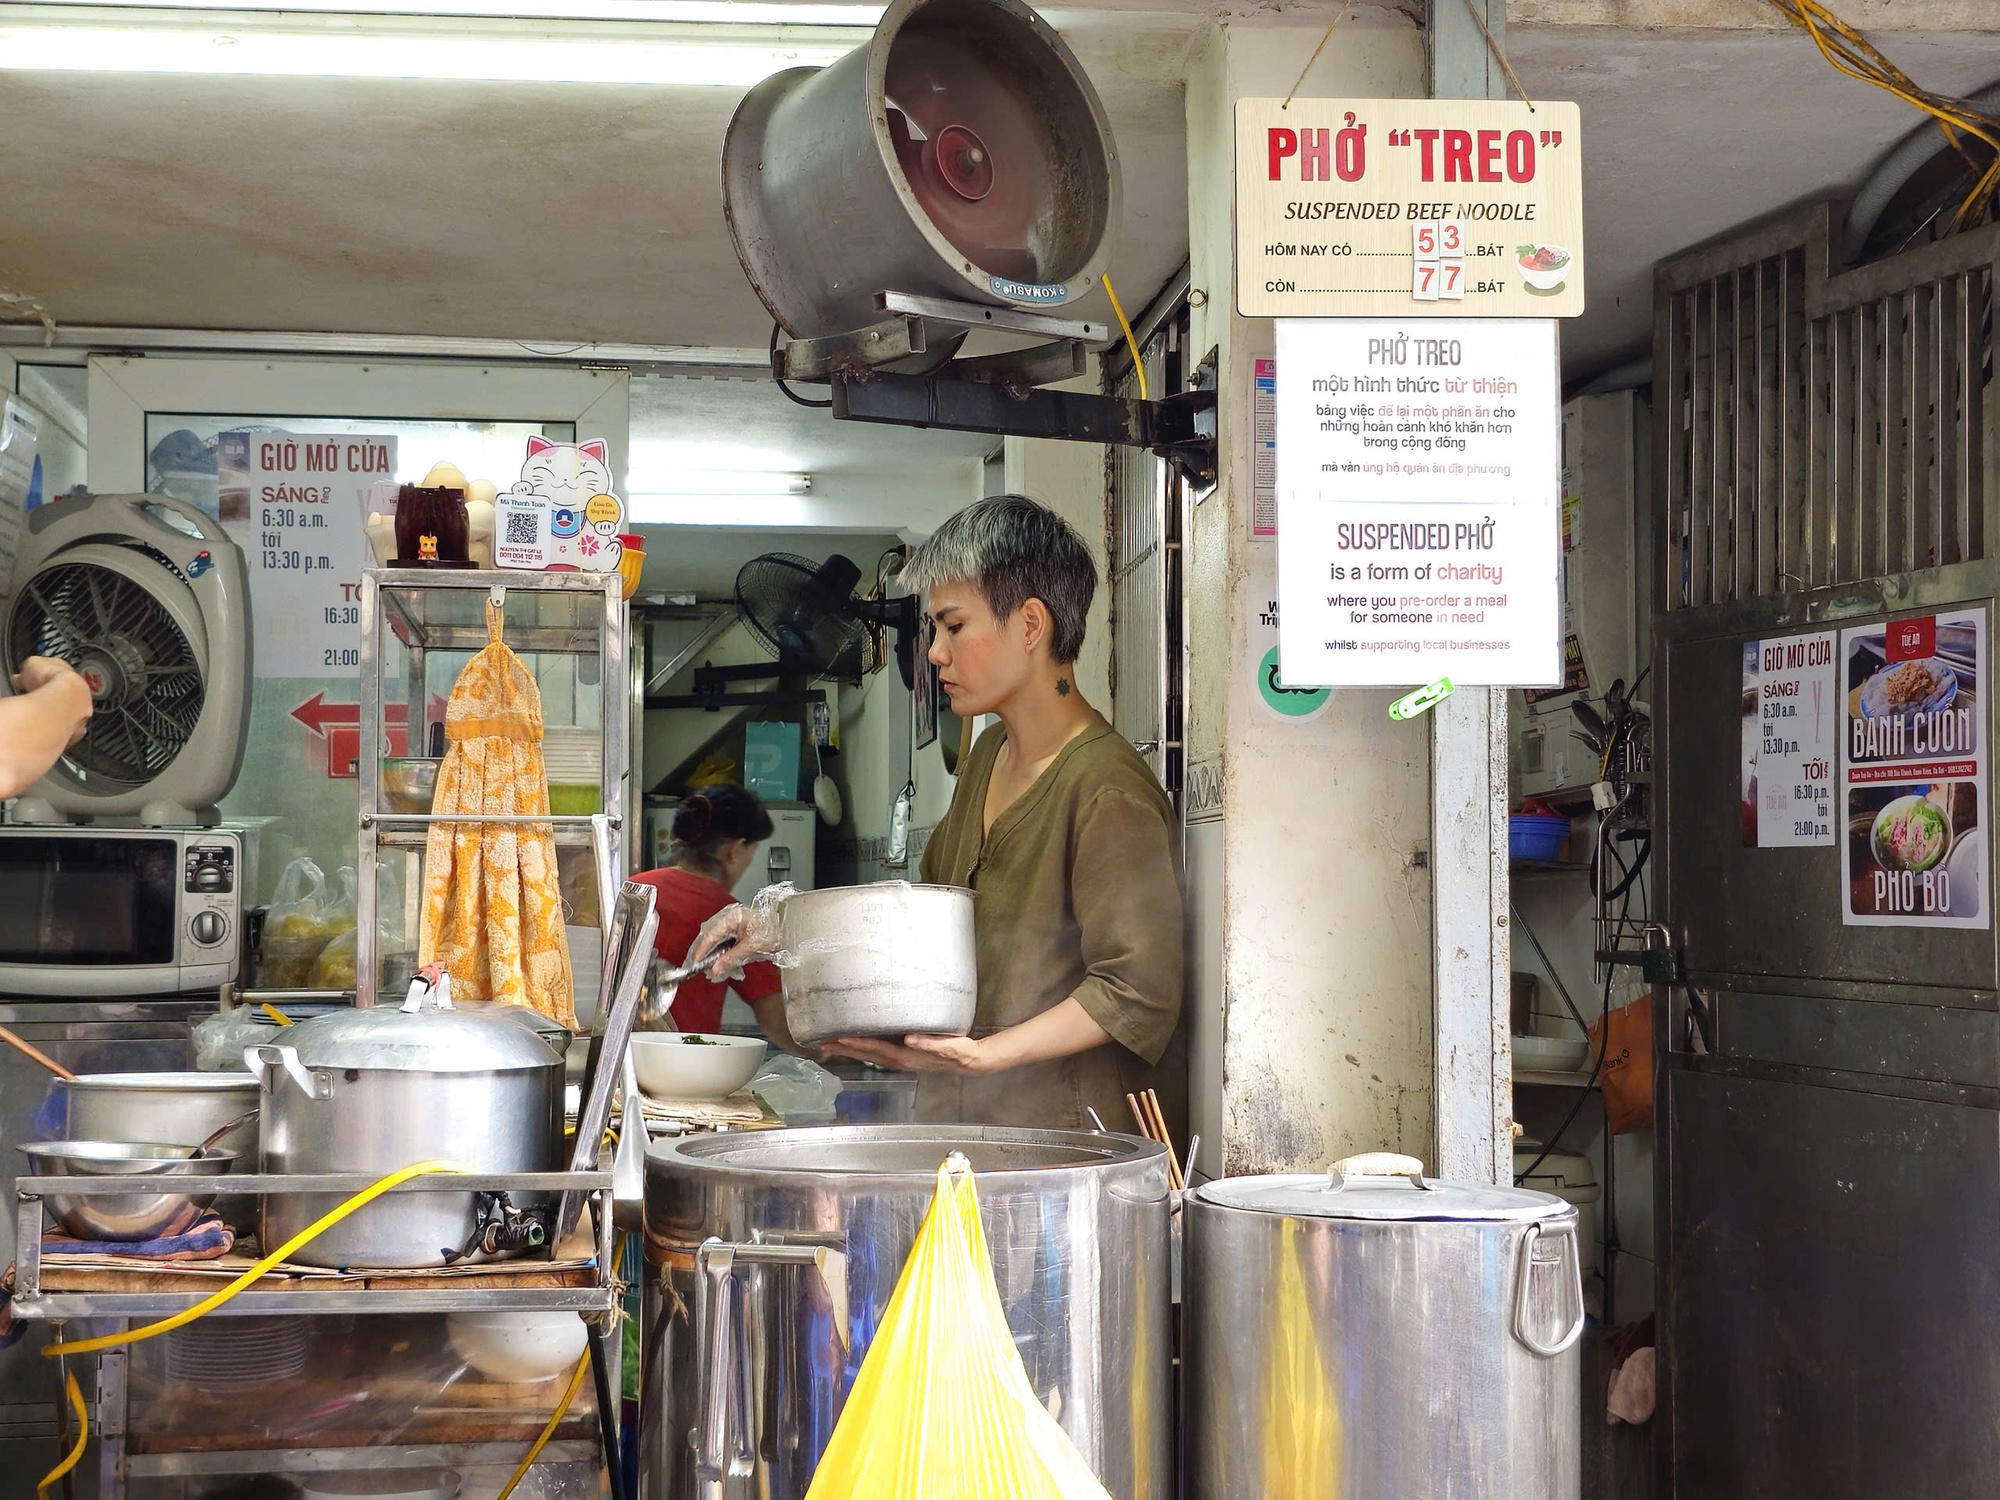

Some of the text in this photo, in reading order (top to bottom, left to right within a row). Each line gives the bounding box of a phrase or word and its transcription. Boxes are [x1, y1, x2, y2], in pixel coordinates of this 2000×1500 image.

[1268, 111, 1367, 182] PHỞ
[1285, 202, 1536, 221] SUSPENDED BEEF NOODLE
[1265, 242, 1296, 256] HÔM
[1301, 245, 1328, 256] NAY
[1331, 243, 1352, 256] CÓ
[1265, 278, 1295, 292] CÒN
[1368, 331, 1461, 366] PHỞ TREO
[1312, 374, 1518, 398] một hình thức từ thiện
[1350, 404, 1375, 419] việc
[1396, 405, 1410, 420] lại
[1412, 404, 1439, 420] một
[1493, 406, 1516, 418] cho
[1320, 419, 1360, 435] những
[1363, 420, 1393, 432] hoàn
[1429, 420, 1452, 433] khó
[1455, 421, 1484, 433] khăn
[1487, 421, 1512, 434] hơn
[1363, 436, 1398, 451] trong
[1401, 435, 1432, 451] cộng
[261, 438, 390, 473] GIỜ MỞ CỬA
[1467, 463, 1511, 477] phương
[261, 482, 319, 503] SÁNG
[262, 509, 329, 528] 6:30 a.m.
[261, 531, 281, 548] tới
[1337, 516, 1496, 550] SUSPENDED PHỞ
[263, 551, 335, 574] 13:30 p.m.
[1330, 563, 1503, 585] is a form of charity
[1327, 594, 1507, 610] where you pre-order a meal
[324, 607, 359, 624] 16:30
[1350, 611, 1484, 623] for someone in need
[1325, 640, 1511, 653] whilst supporting local businesses
[1764, 636, 1832, 672] GIỜ MỞ CỬA
[324, 649, 359, 666] 21:00
[1763, 680, 1793, 699] SÁNG
[1763, 702, 1798, 719] 6:30 a.m.
[1853, 709, 1905, 758] BÁNH
[1763, 738, 1801, 757] 13:30 p.m.
[1794, 784, 1830, 802] 16:30 p.m.
[1794, 821, 1830, 840] 21:00 p.m.
[1873, 861, 1916, 912] PHỞ
